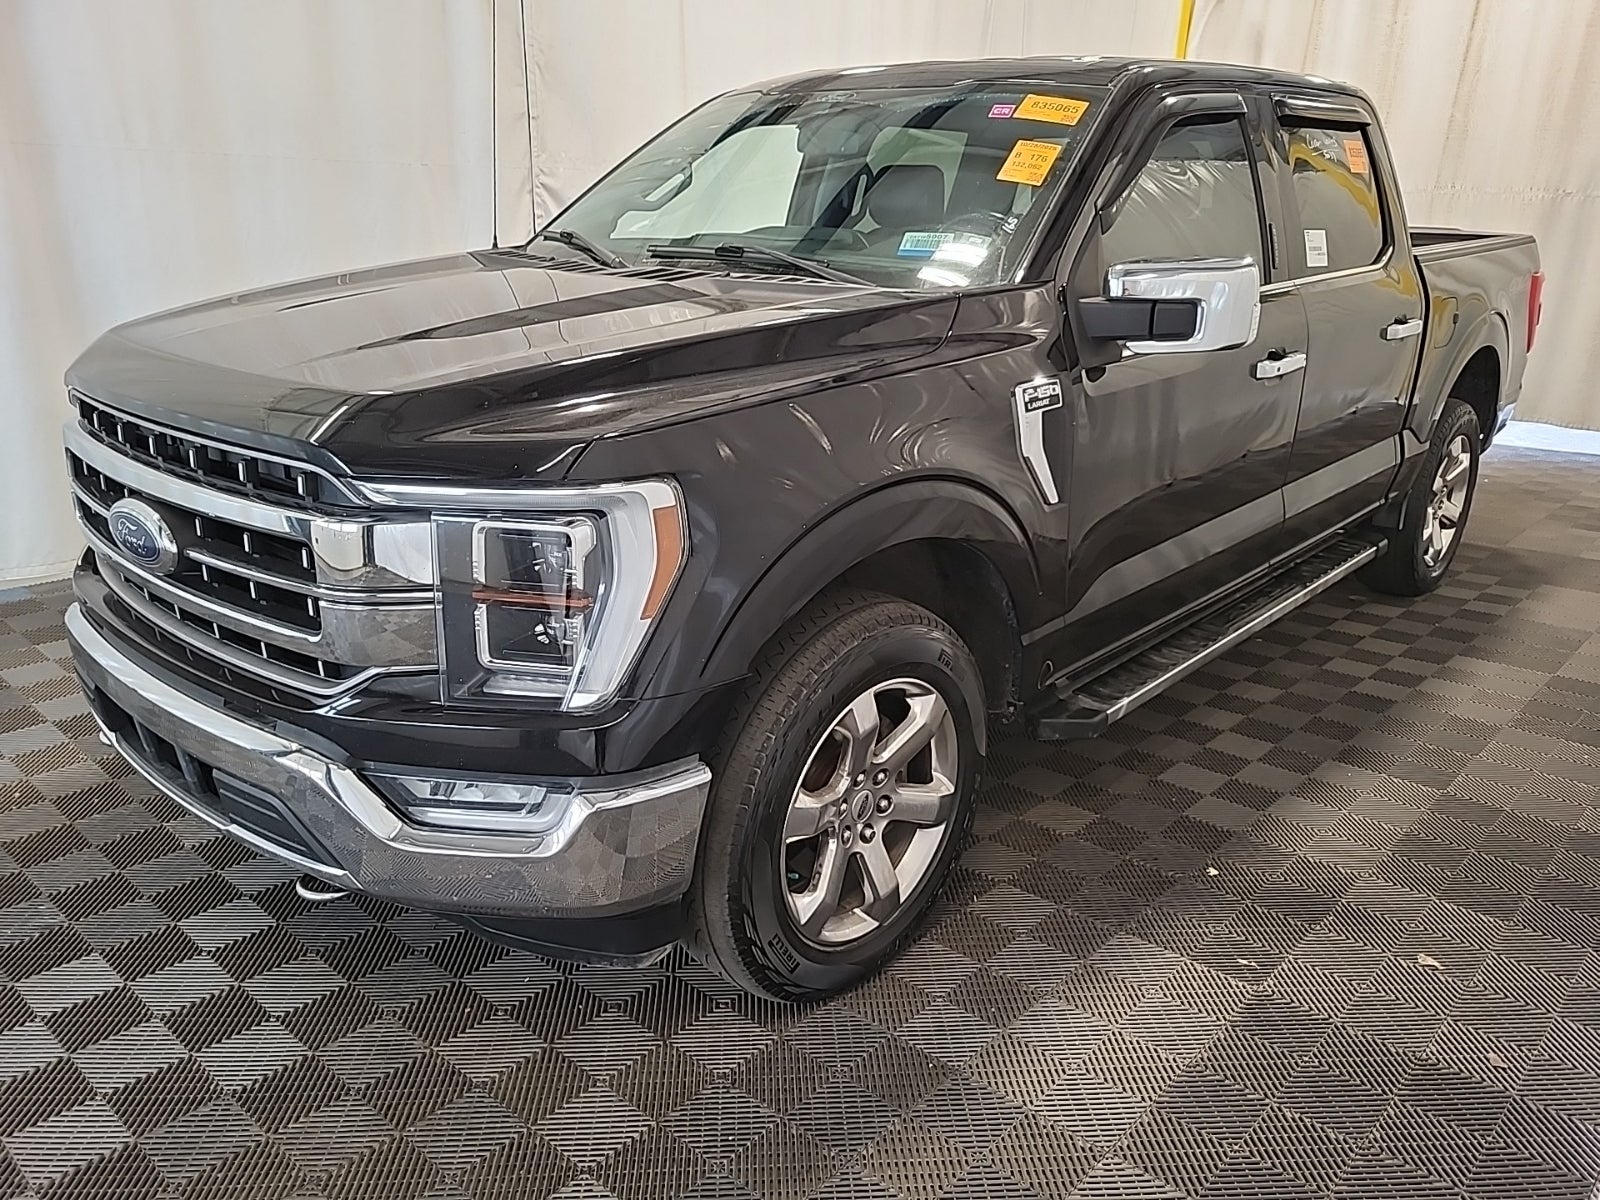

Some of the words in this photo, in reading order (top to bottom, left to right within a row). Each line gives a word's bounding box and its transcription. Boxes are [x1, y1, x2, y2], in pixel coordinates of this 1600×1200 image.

[993, 107, 1010, 115] CR
[1031, 101, 1081, 114] 835065
[1030, 153, 1048, 163] 176
[1001, 216, 1019, 234] 165
[1024, 384, 1059, 402] F-150
[1027, 398, 1051, 410] LARIAT
[116, 518, 147, 555] Ford
[768, 933, 801, 975] PIRELLI
